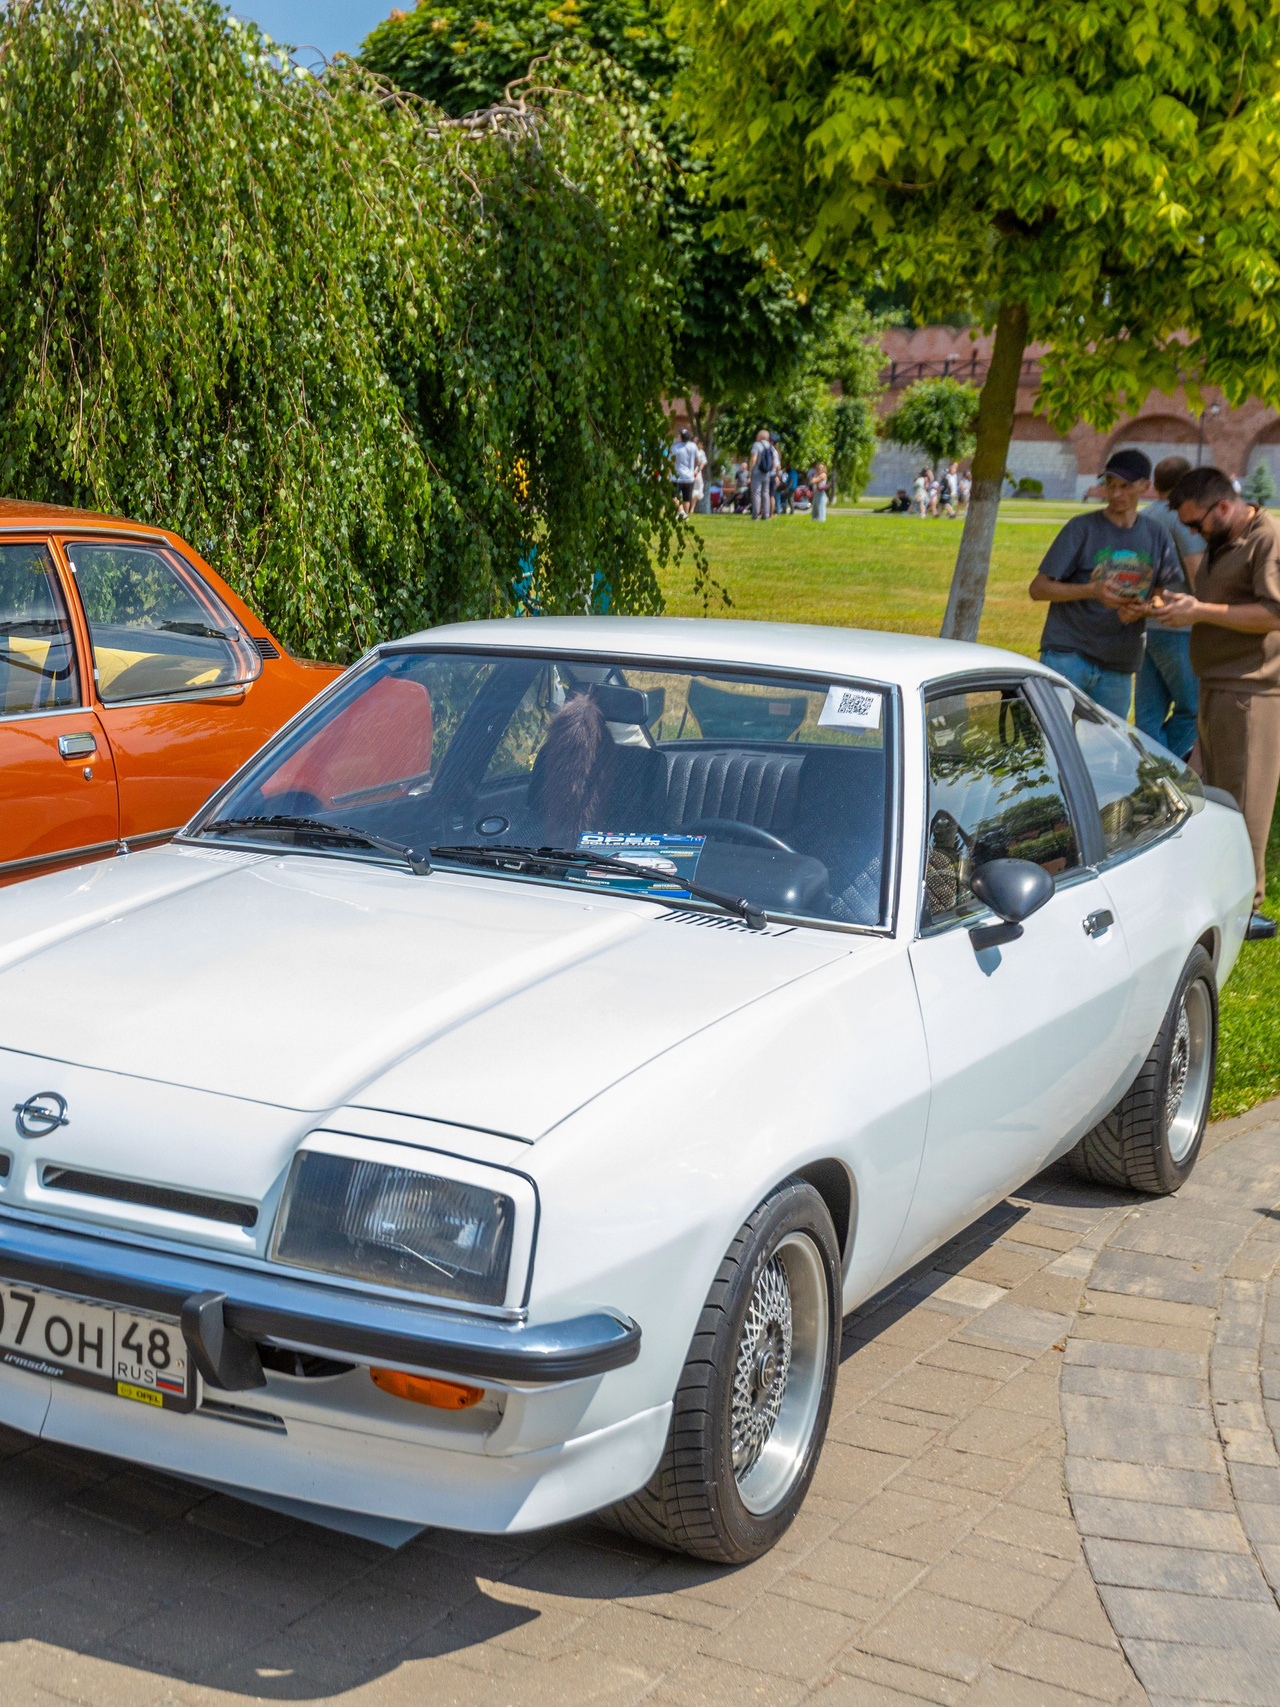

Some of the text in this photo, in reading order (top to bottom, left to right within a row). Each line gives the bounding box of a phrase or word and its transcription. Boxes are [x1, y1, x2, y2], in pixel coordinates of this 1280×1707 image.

[581, 835, 653, 843] OPEL
[121, 1321, 171, 1369] 48
[117, 1362, 154, 1384] RUS
[136, 1389, 160, 1405] OPEL
